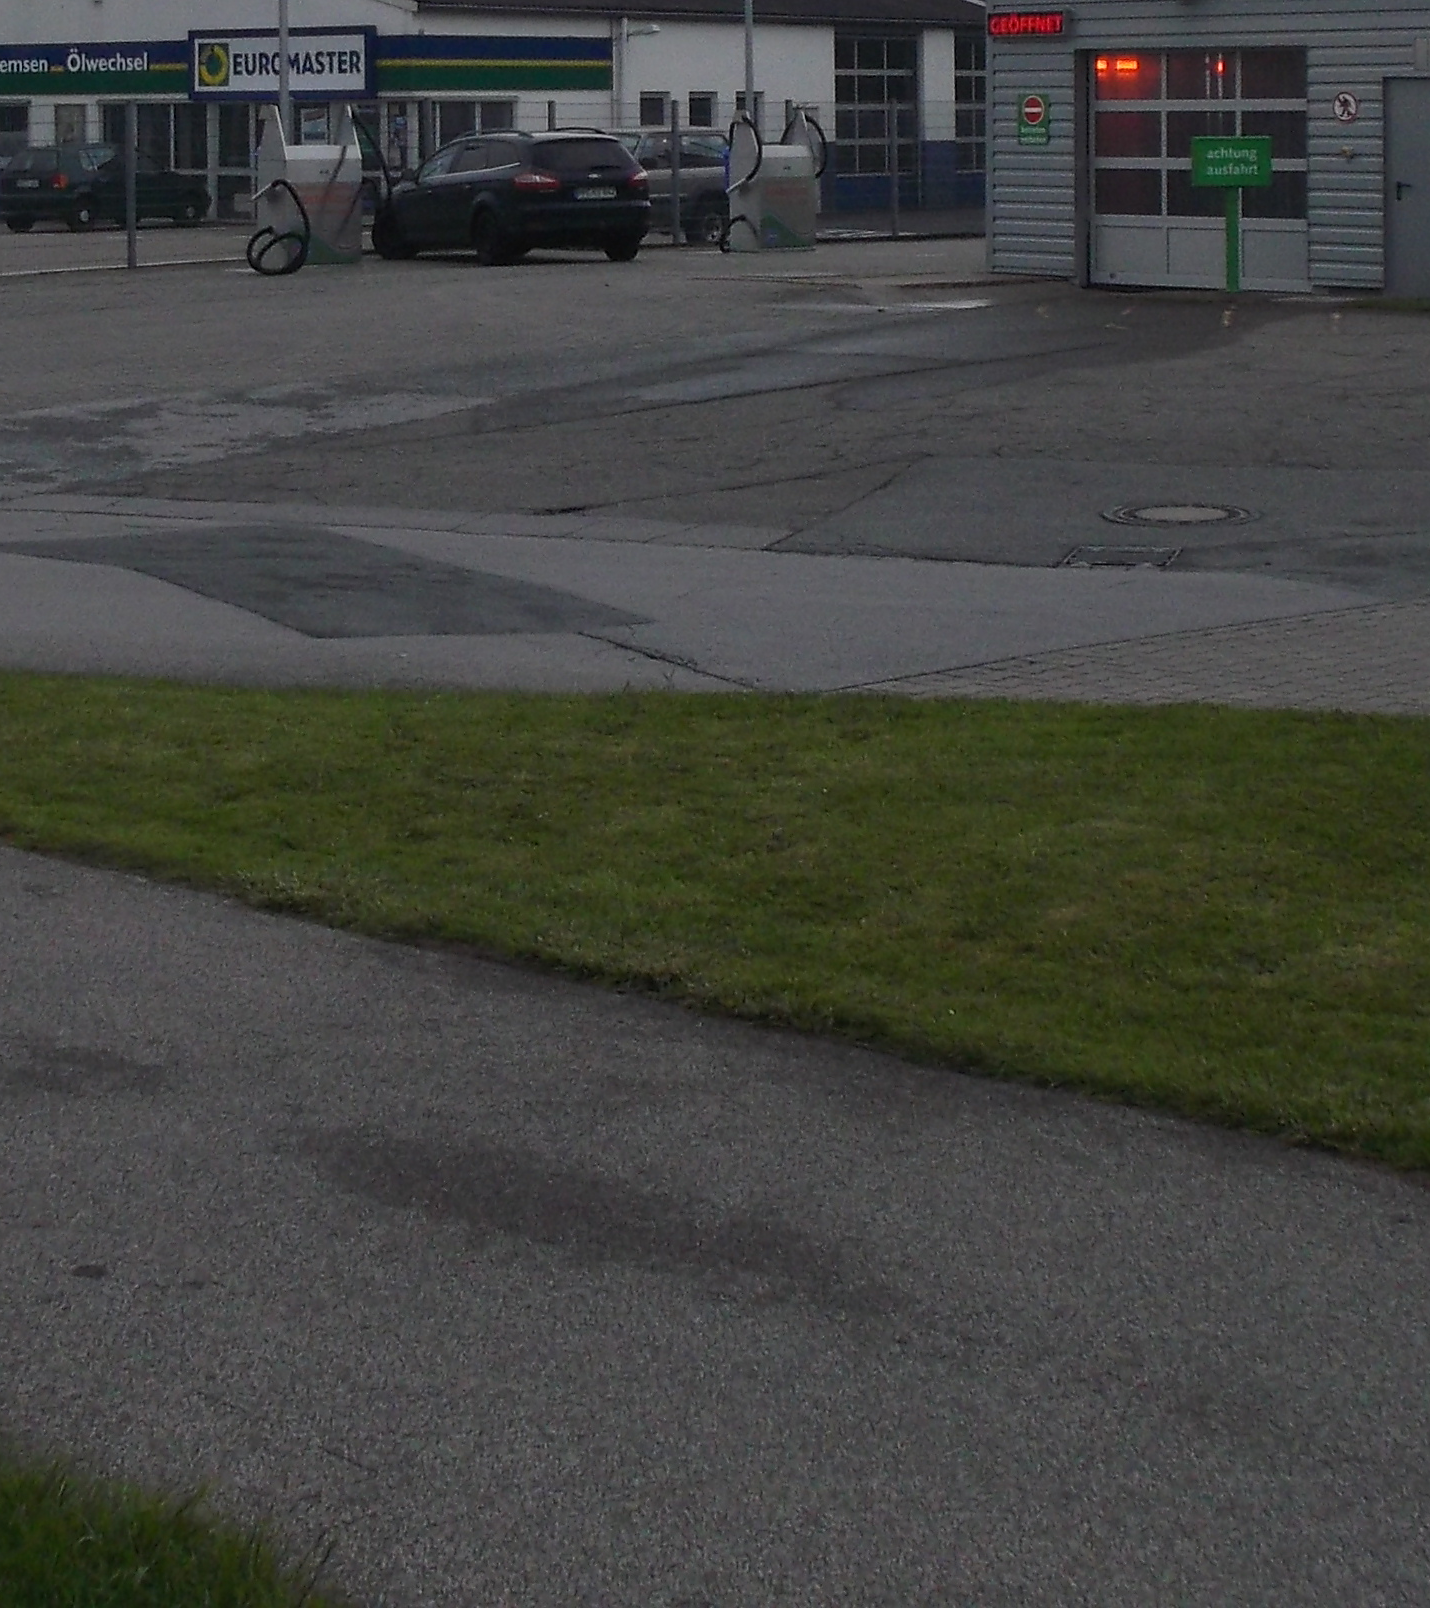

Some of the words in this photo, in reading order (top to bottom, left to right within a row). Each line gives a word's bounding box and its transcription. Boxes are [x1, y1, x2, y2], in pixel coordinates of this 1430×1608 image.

[66, 48, 149, 74] Ölwechsel
[232, 49, 362, 77] EUROMASTER
[1205, 146, 1258, 162] achtung
[1205, 161, 1260, 176] ausfahrt
